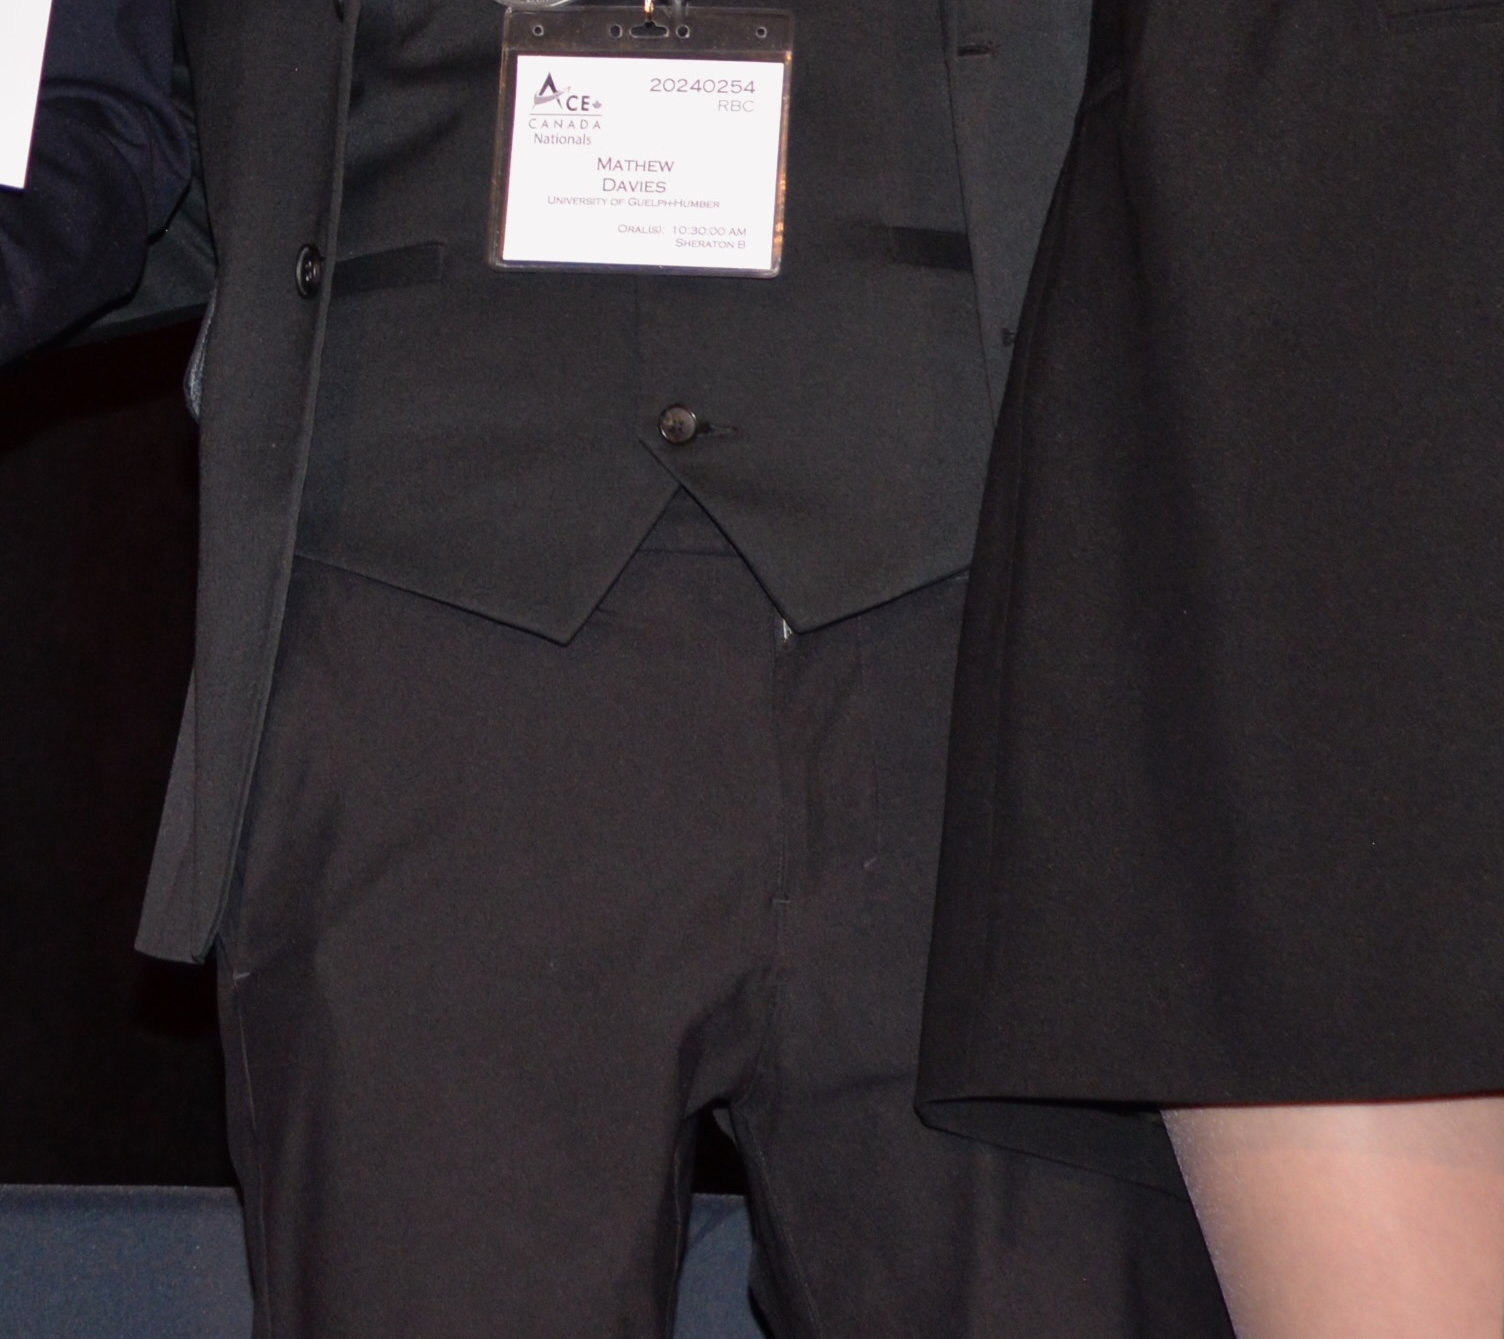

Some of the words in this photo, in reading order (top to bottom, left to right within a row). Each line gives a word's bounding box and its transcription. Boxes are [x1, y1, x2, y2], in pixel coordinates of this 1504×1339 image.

[650, 78, 756, 94] 20240254
[718, 100, 755, 113] RBC
[528, 119, 601, 130] CANADA
[533, 132, 592, 145] Nationals
[728, 227, 747, 237] AM
[737, 240, 746, 250] B
